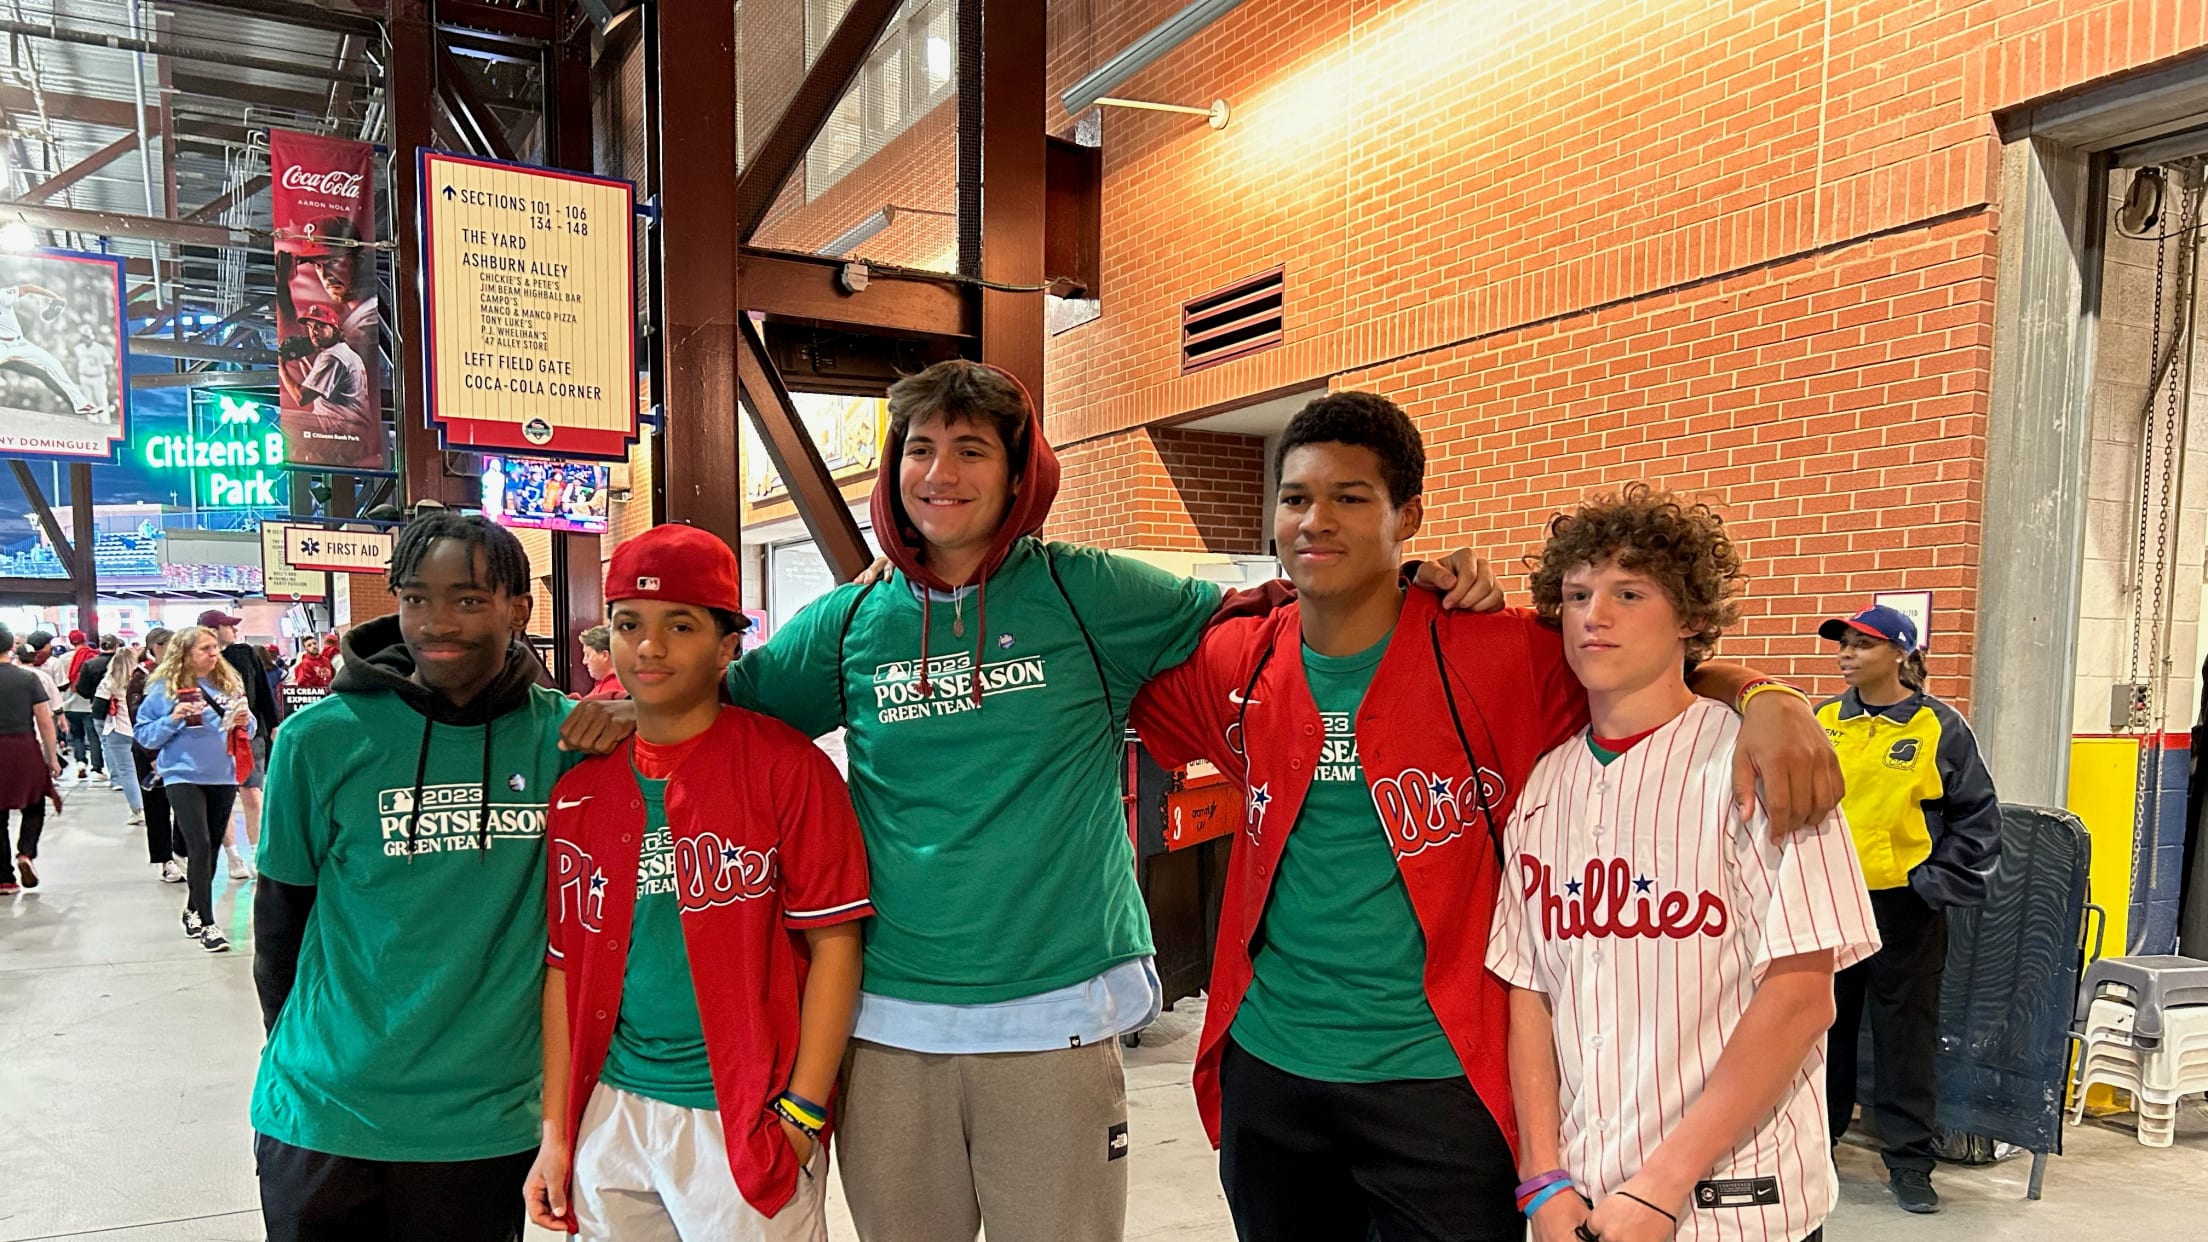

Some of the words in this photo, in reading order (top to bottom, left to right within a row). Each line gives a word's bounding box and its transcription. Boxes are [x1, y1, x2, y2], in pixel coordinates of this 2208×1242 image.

[297, 199, 326, 208] AARON
[329, 203, 351, 211] NOLA
[461, 189, 526, 212] SECTIONS
[531, 200, 550, 215] 101
[565, 205, 587, 220] 106
[530, 216, 552, 231] 134
[566, 221, 588, 236] 148
[462, 228, 486, 245] THE
[491, 232, 526, 250] YARD
[462, 252, 525, 273] ASHBURN
[530, 261, 568, 279] ALLEY
[480, 272, 521, 285] CHICKIE'S
[524, 278, 530, 287] &
[533, 279, 560, 291] PETE'S
[480, 283, 495, 292] JIM
[498, 284, 521, 295] BEAM
[523, 288, 563, 302] HIGHBALL
[565, 293, 582, 303] BAR
[480, 294, 518, 306] CAMPO'S
[480, 304, 511, 316] MANCO
[513, 308, 519, 317] &
[521, 309, 551, 320] MANCO
[554, 313, 577, 323] PIZZA
[481, 315, 505, 325] TONY
[505, 316, 533, 329] LUKE'S
[481, 325, 494, 335] P.J.
[497, 327, 548, 341] WHELIHAN'S
[497, 337, 521, 348] ALLEY
[523, 340, 548, 351] STORE
[464, 352, 493, 367] LEFT
[499, 355, 533, 371] FIELD
[539, 359, 571, 375] GATE
[465, 374, 544, 395] COCA-COLA
[550, 382, 602, 400] CORNER
[20, 437, 99, 451] DOMINGUEZ
[146, 434, 260, 468] Citizens
[210, 469, 276, 505] Park
[327, 541, 357, 556] FIRST
[361, 544, 379, 557] AID
[874, 660, 1045, 708] POSTSEASON
[878, 702, 931, 724] GREEN
[932, 697, 981, 716] TEAM
[422, 788, 483, 805] 2023
[1173, 806, 1182, 840] 3
[384, 838, 441, 857] GREEN
[1520, 854, 1728, 941] Phillies
